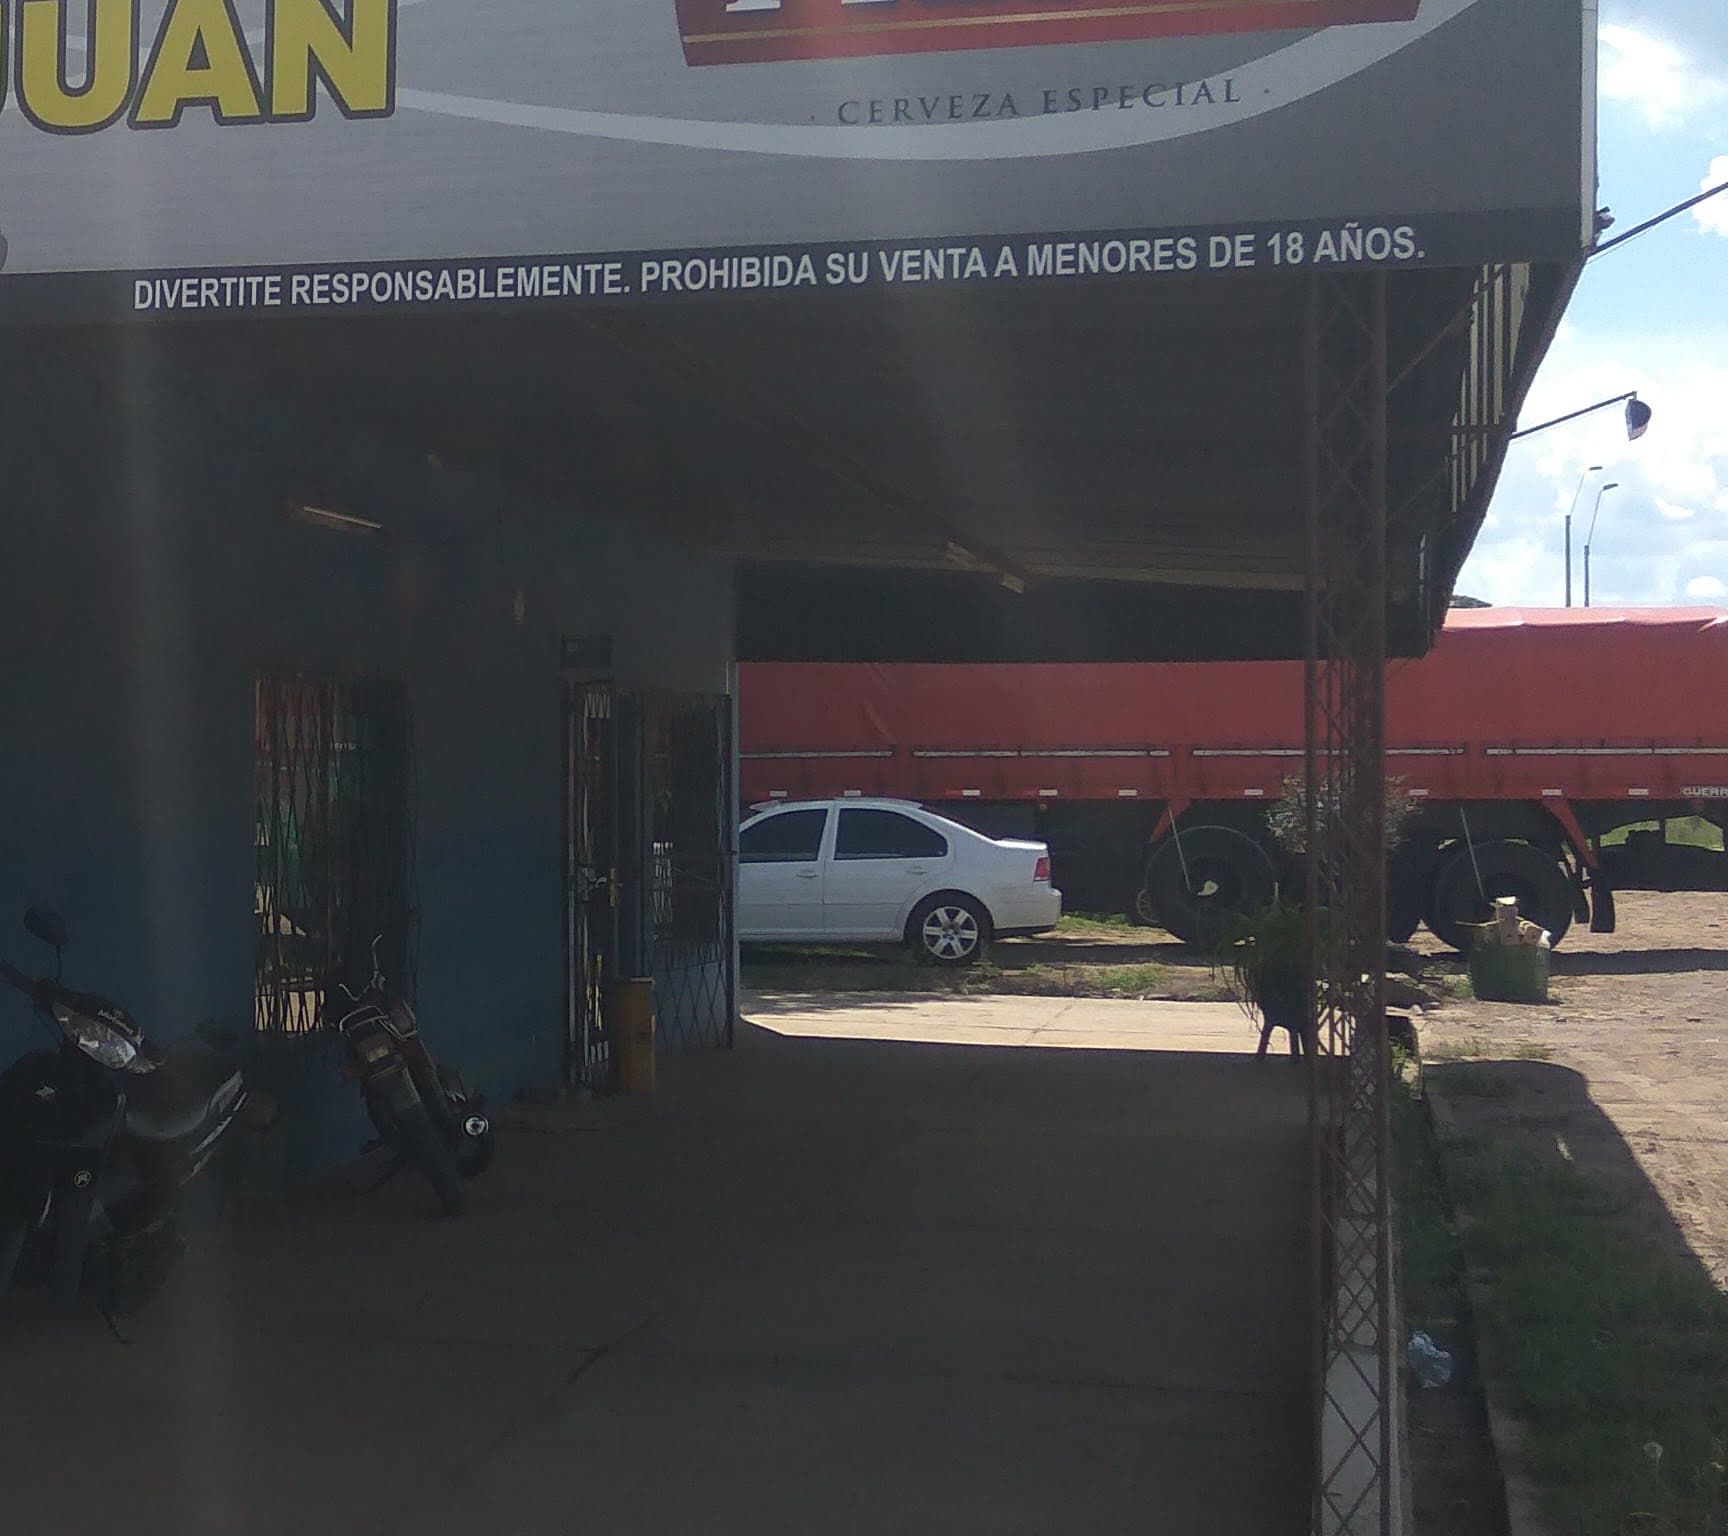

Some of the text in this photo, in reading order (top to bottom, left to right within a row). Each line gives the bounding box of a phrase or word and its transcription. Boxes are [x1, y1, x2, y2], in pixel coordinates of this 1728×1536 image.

[837, 77, 1241, 126] CERVEZA ESPECIAL
[134, 221, 1426, 310] DIVERTITE RESPONSABLEMENTE. PROHIBIDA SU VENTA A MENORES DE 18 AÑOS.
